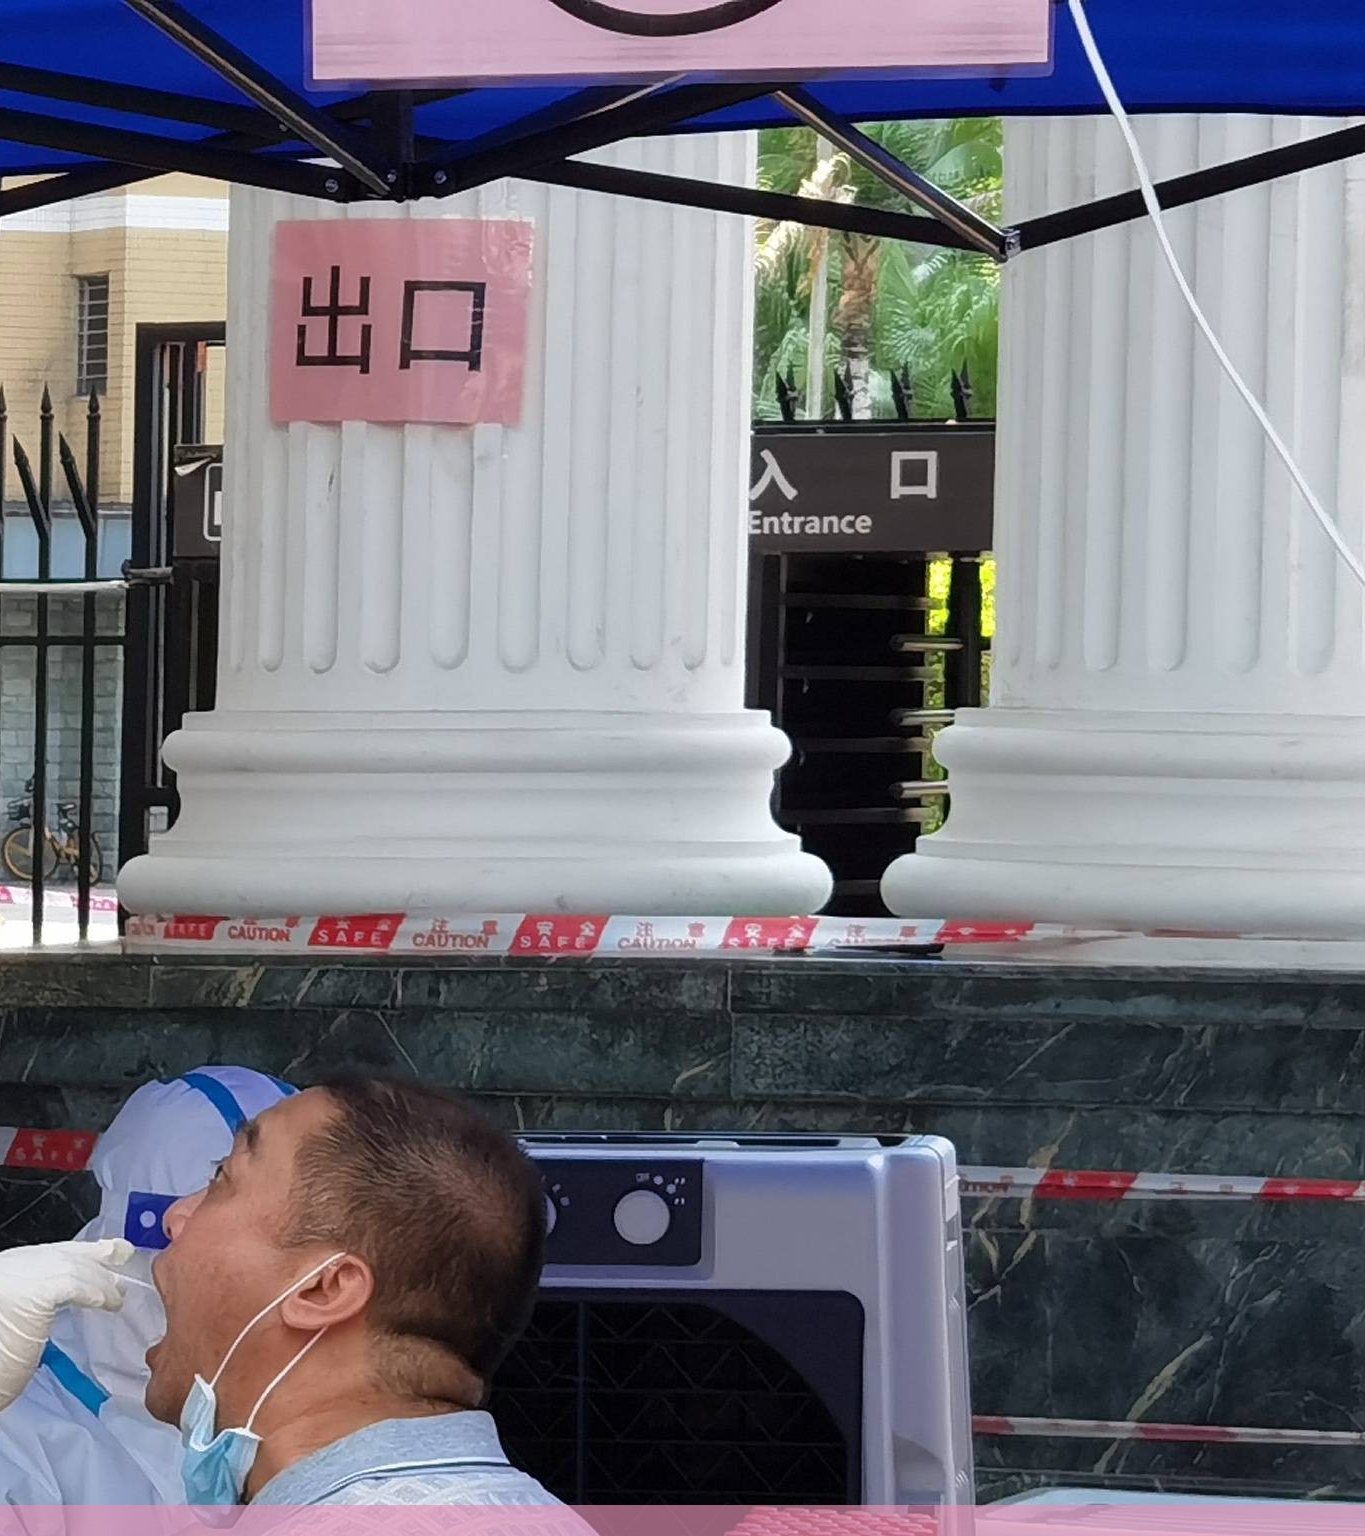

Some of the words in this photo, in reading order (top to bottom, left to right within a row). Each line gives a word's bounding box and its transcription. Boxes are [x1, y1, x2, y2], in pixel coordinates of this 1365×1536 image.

[296, 265, 486, 374] 出口
[748, 449, 938, 501] 入口
[748, 510, 873, 534] Entrance
[228, 925, 292, 942] CAUTION
[317, 930, 383, 946] SAFE
[411, 932, 492, 949] CAUTION
[519, 936, 590, 949] SAFE
